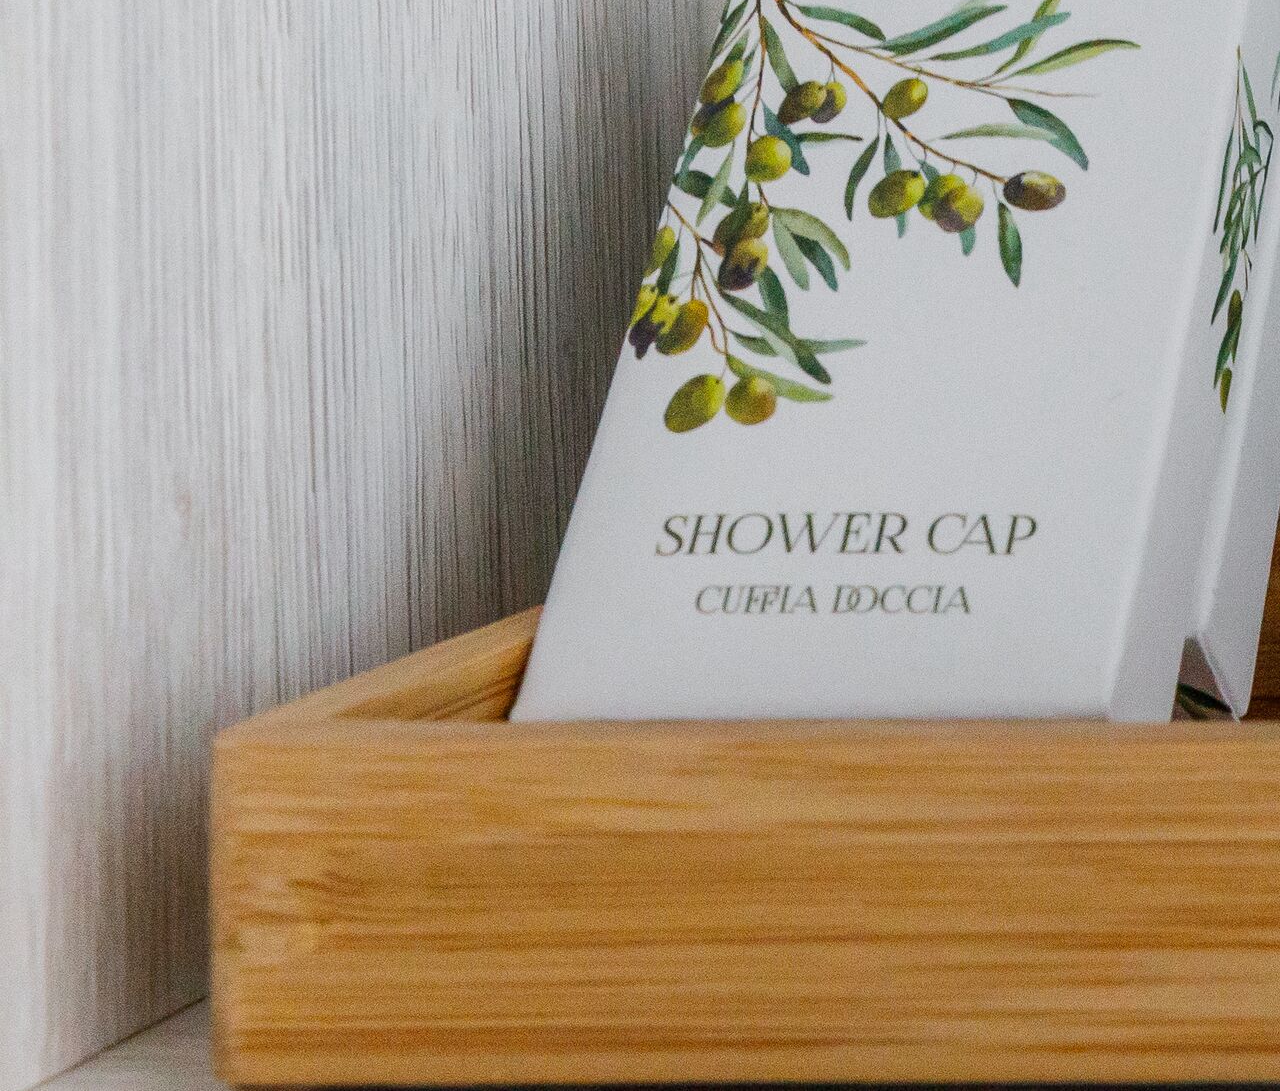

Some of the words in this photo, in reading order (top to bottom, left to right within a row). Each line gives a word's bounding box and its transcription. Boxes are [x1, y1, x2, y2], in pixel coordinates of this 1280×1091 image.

[655, 511, 909, 557] SHOWER
[926, 512, 1038, 556] CAP
[694, 584, 818, 615] CUFFIA
[831, 584, 972, 614] DOCCIA
